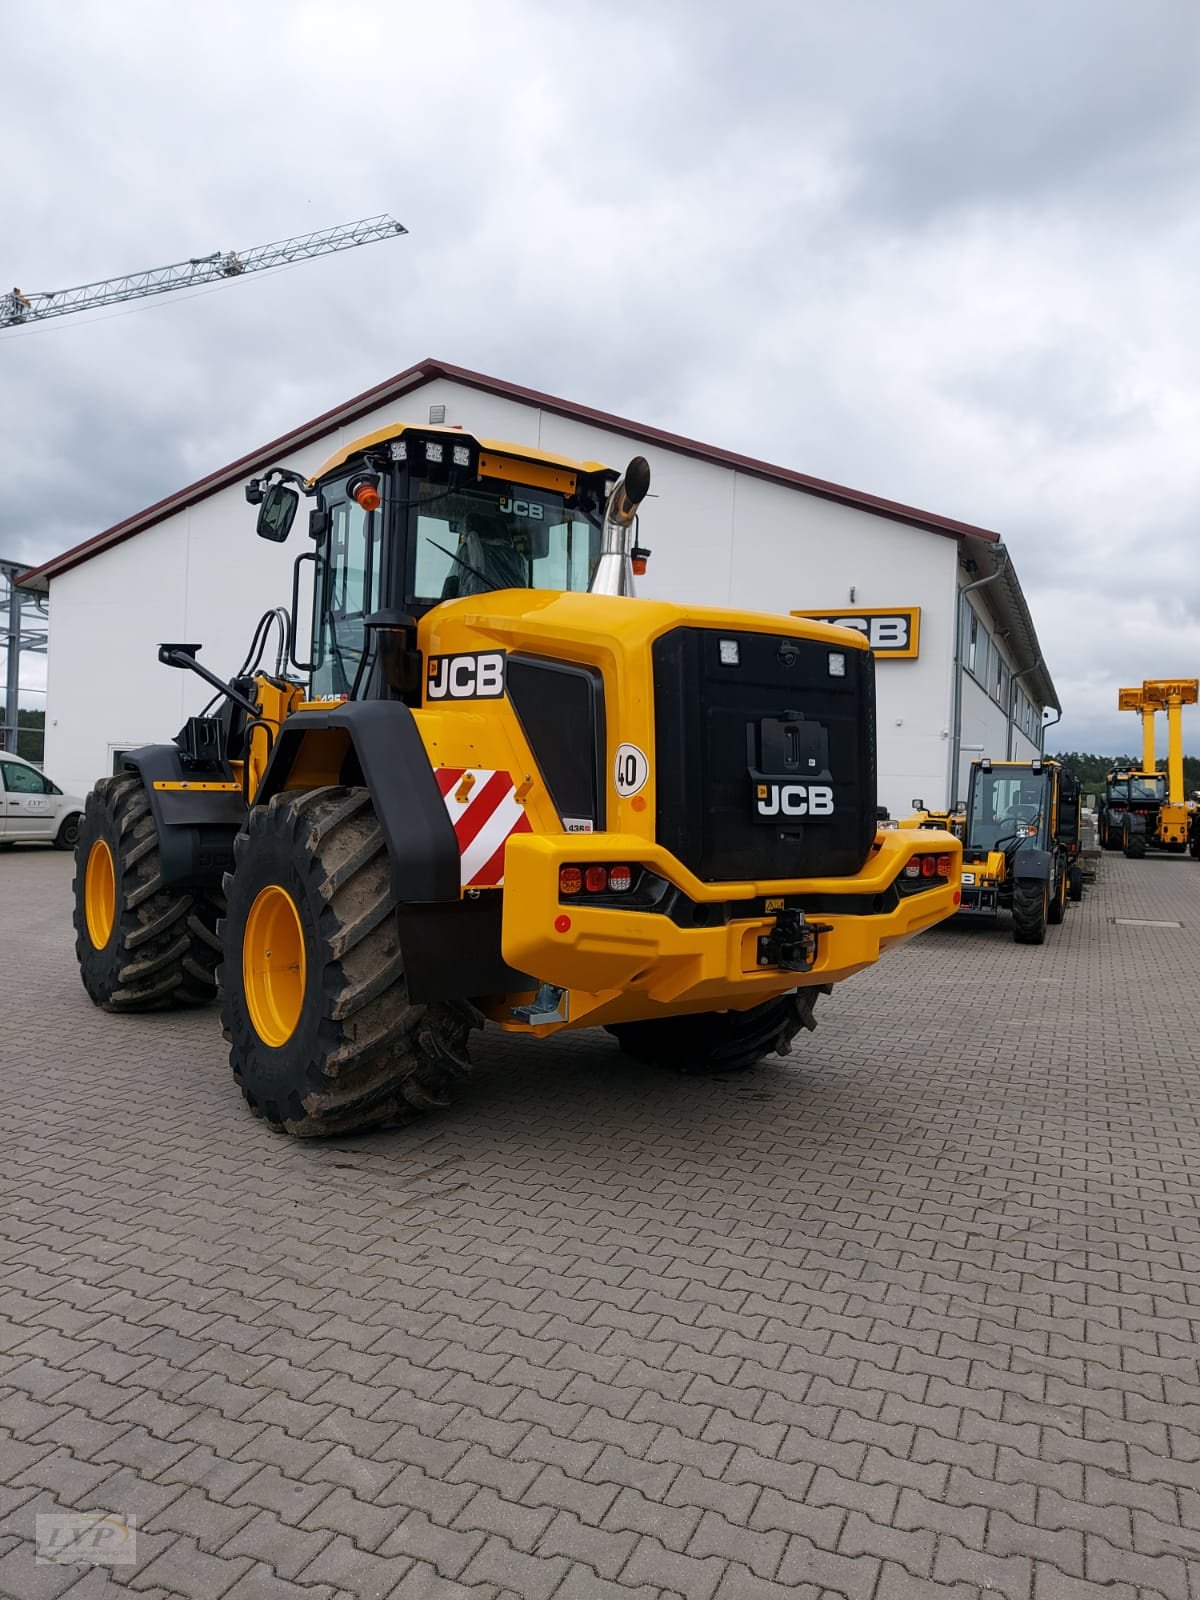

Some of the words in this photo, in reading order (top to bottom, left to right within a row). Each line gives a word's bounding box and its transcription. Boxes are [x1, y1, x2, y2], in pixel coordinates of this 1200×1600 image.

[500, 498, 544, 520] JCB
[428, 654, 503, 698] JCB
[617, 754, 637, 786] 40
[757, 785, 834, 815] JCB
